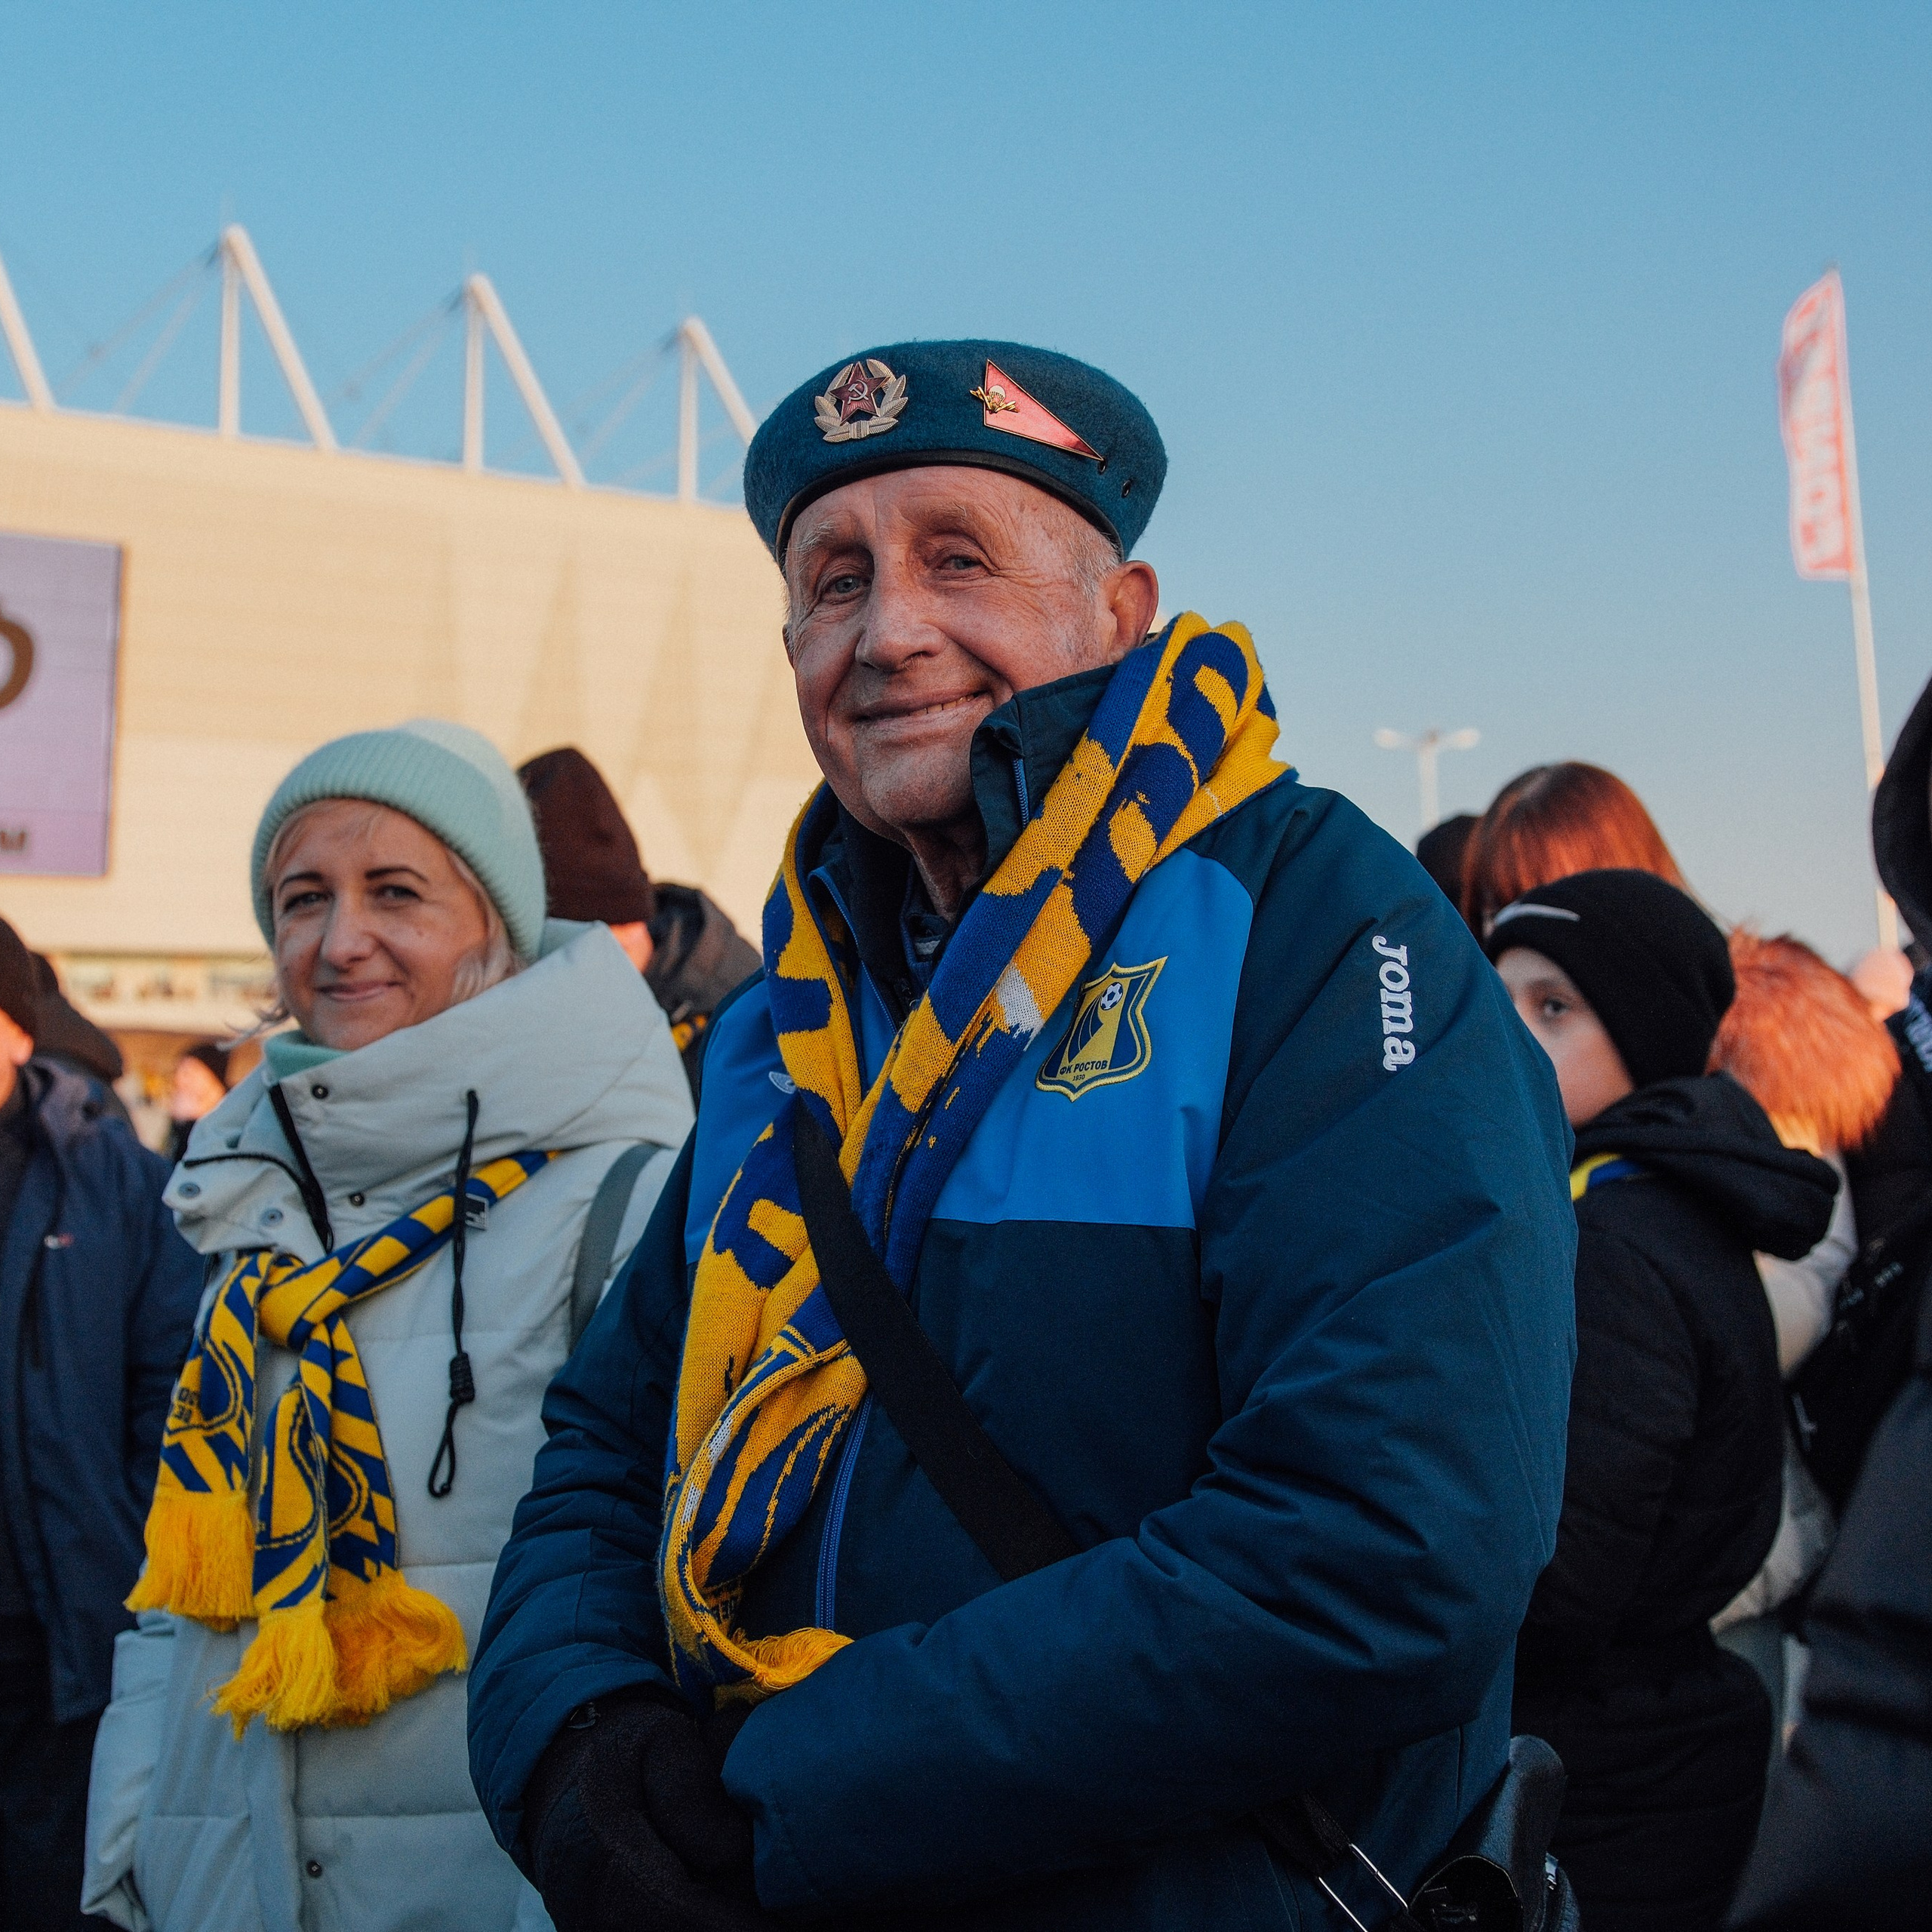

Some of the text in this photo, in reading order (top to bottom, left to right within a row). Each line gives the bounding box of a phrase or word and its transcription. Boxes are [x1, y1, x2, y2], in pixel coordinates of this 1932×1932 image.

[1372, 935, 1416, 1072] Joma
[1060, 1060, 1108, 1075] ФК РОСТОВ
